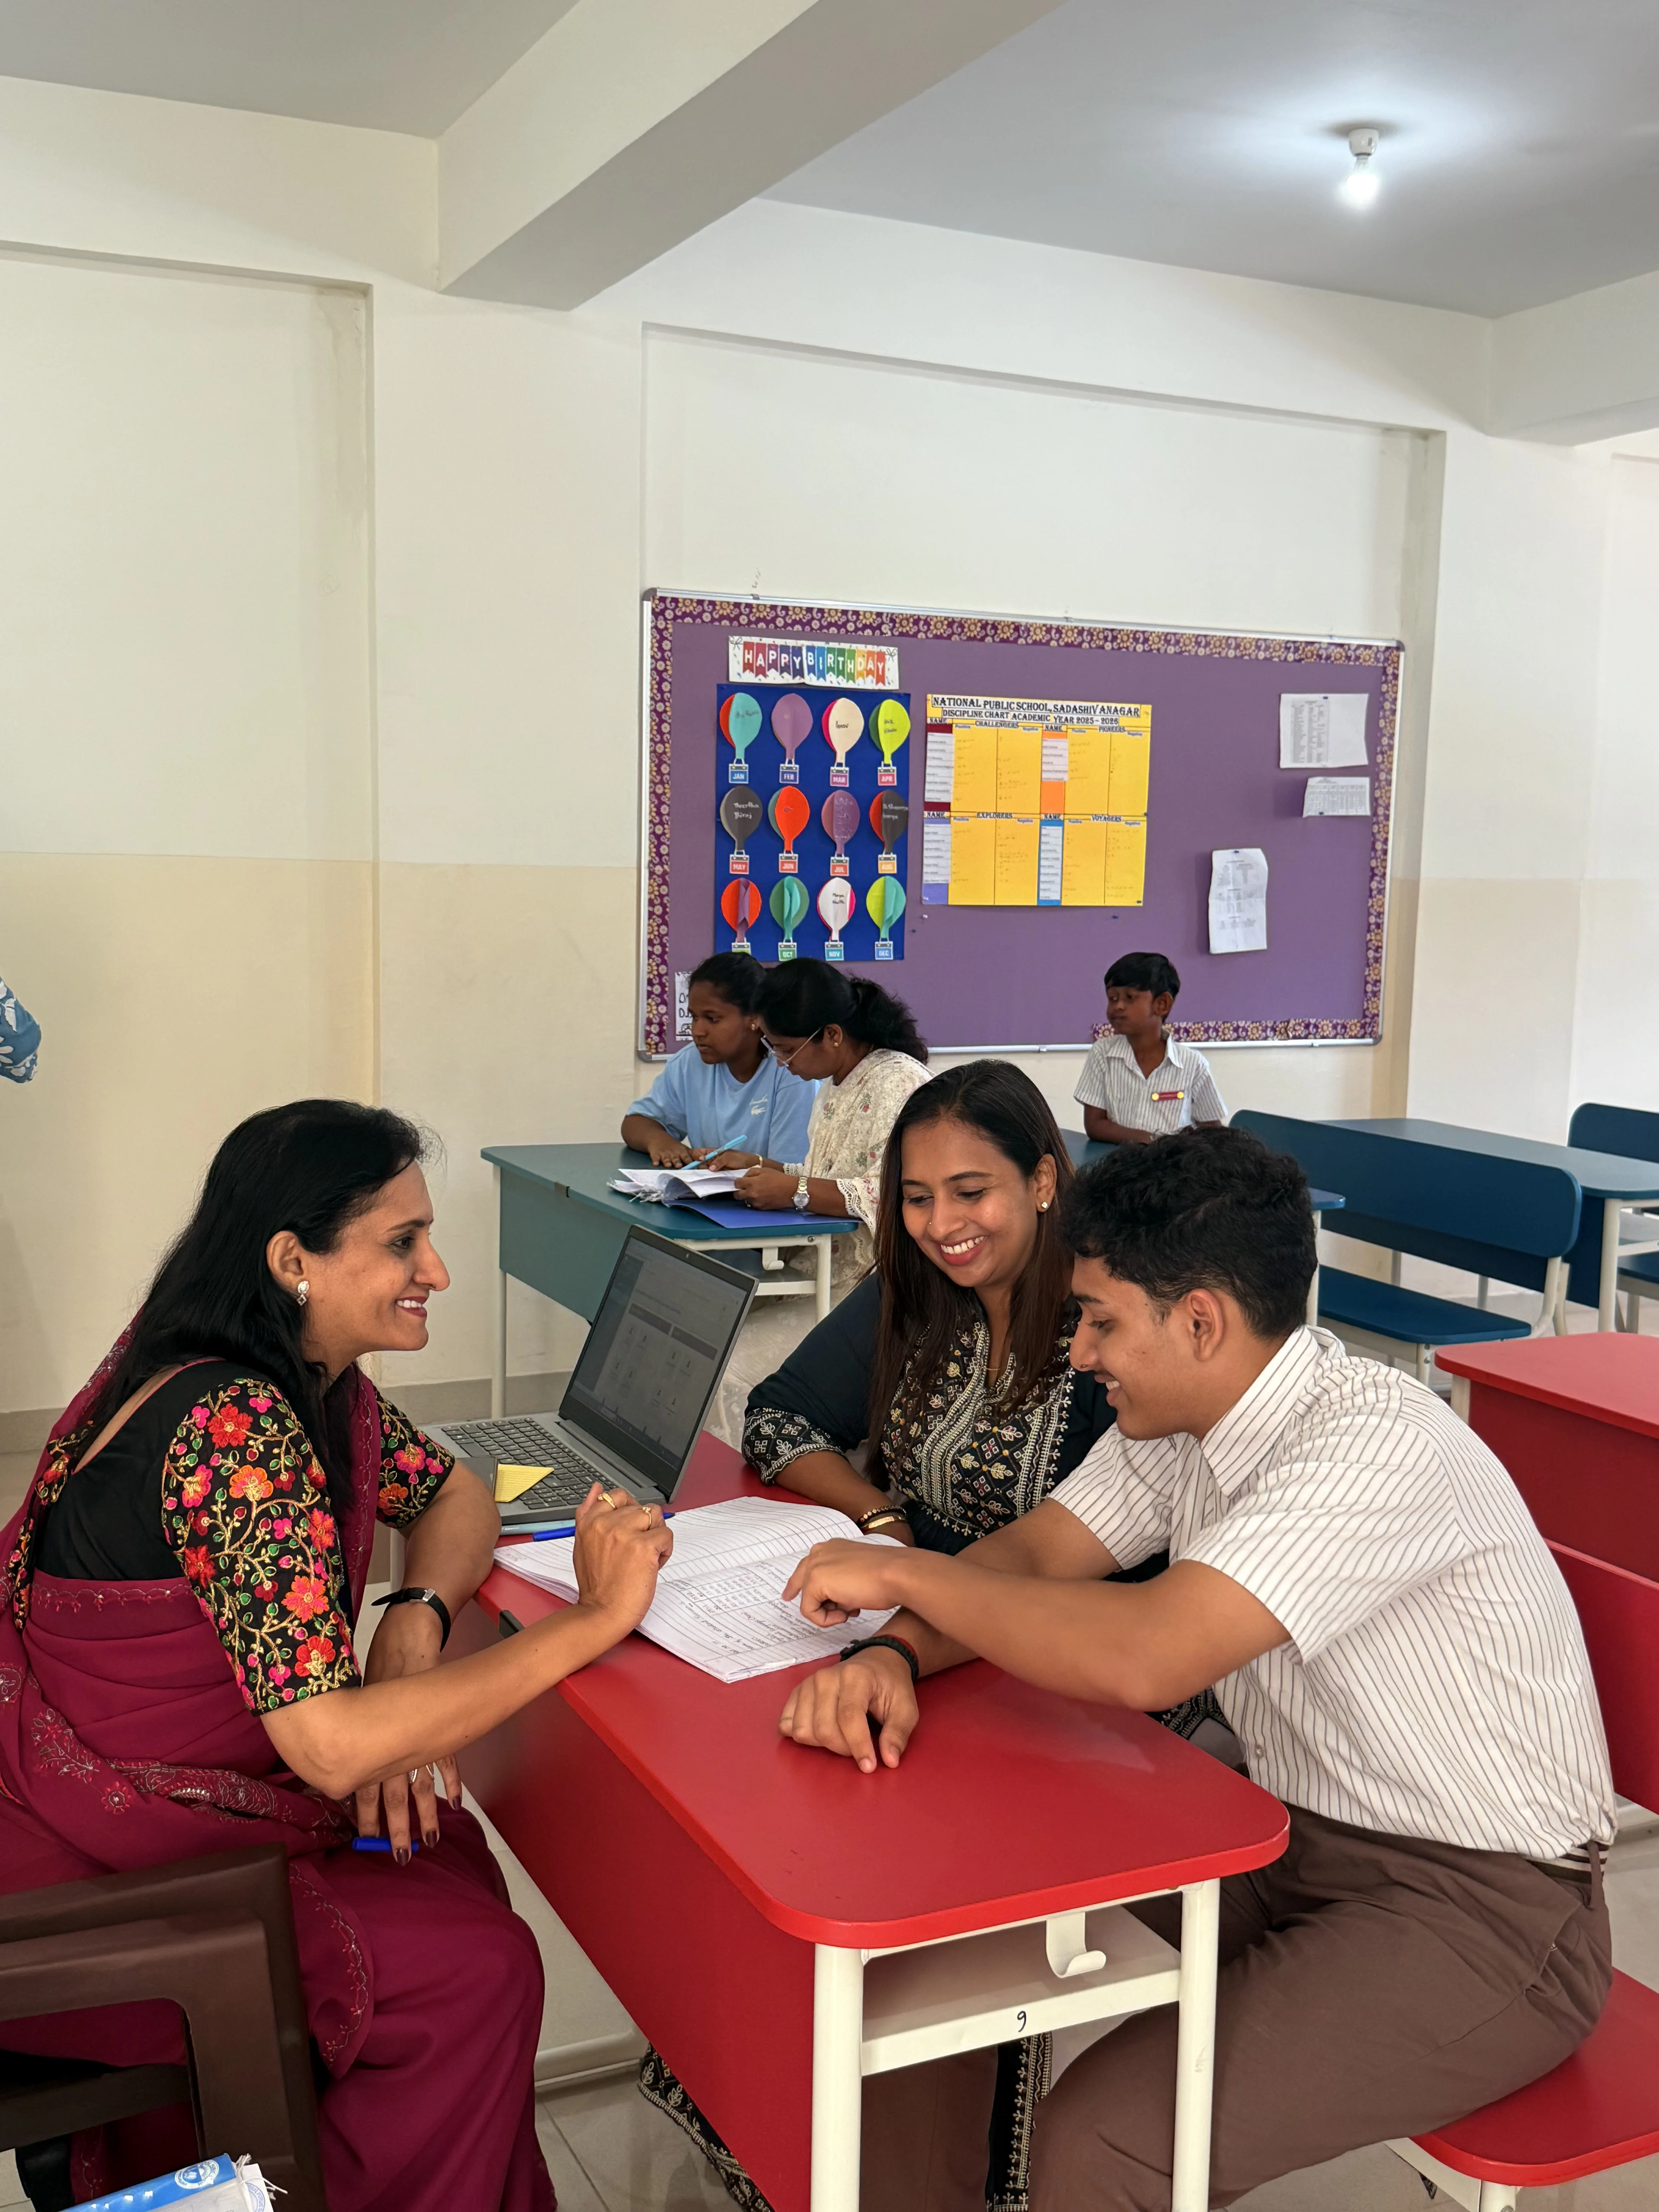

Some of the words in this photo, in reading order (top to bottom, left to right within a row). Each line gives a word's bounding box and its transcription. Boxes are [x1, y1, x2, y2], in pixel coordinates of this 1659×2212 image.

[744, 649, 800, 670] HAPPY
[807, 651, 884, 675] BIRTHDAY
[933, 697, 981, 707] NATIONAL
[983, 701, 1015, 709] PUBLIC
[1016, 702, 1052, 713] SCHOOL,
[943, 709, 982, 717] DISCIPLINE
[1053, 716, 1074, 724] YEAR
[1017, 2010, 1026, 2032] 9
